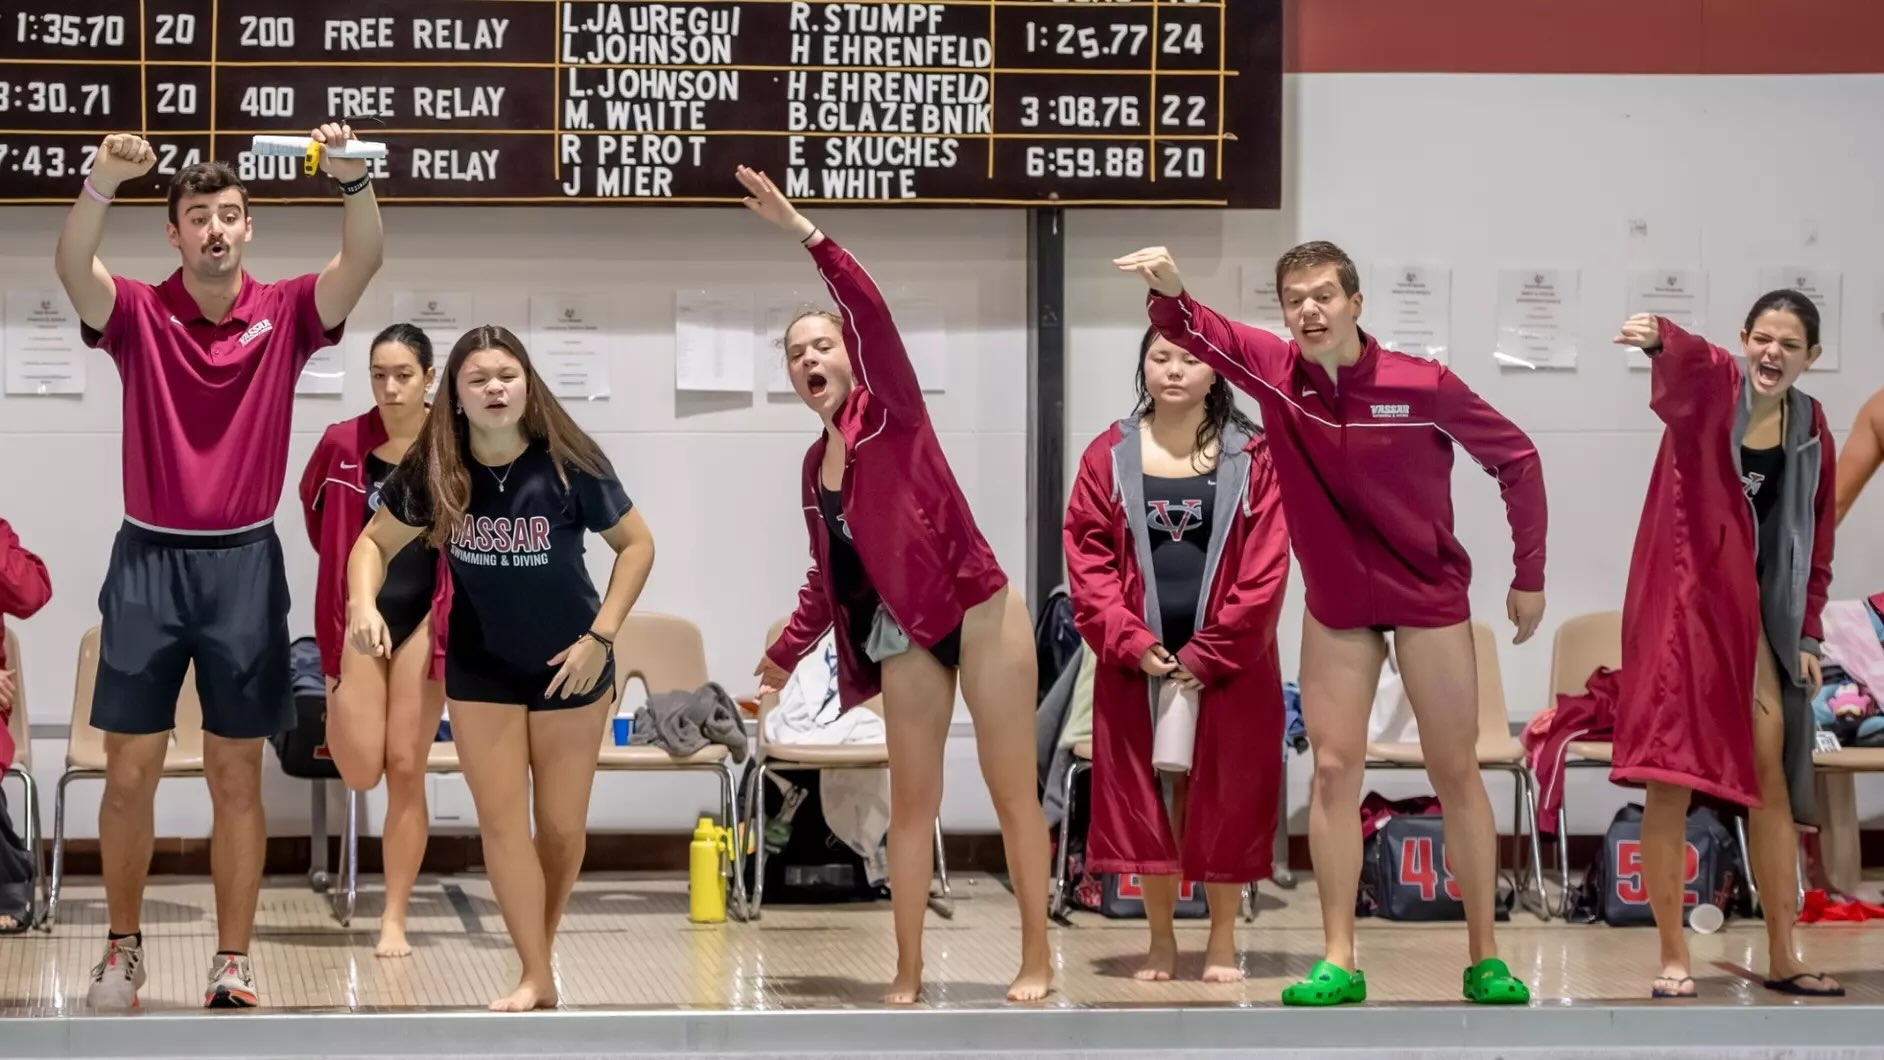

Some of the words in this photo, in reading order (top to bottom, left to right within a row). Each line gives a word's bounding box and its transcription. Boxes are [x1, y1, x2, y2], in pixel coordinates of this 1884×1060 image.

[155, 14, 195, 45] 20
[240, 16, 295, 47] 200
[324, 17, 394, 50] FREE
[413, 18, 509, 50] RELAY
[1162, 23, 1204, 54] 24
[791, 34, 811, 65] H
[823, 35, 992, 68] EHRENFELD
[157, 83, 197, 114] 20
[240, 87, 295, 117] 400
[327, 87, 395, 118] FREE
[413, 87, 505, 119] RELAY
[1161, 95, 1206, 126] 22
[565, 99, 595, 130] M.
[606, 101, 706, 132] WHITE
[411, 149, 500, 181] RELAY
[561, 134, 582, 164] R
[598, 134, 707, 167] PEROT
[789, 136, 806, 166] E
[825, 136, 960, 168] SKUCHES
[1026, 147, 1144, 178] 6:59.88
[1164, 148, 1205, 178] 20
[563, 166, 581, 196] J
[596, 166, 673, 197] MIER
[786, 168, 816, 198] M.
[822, 169, 917, 199] WHITE
[501, 555, 510, 567] &
[513, 553, 549, 567] DIVING
